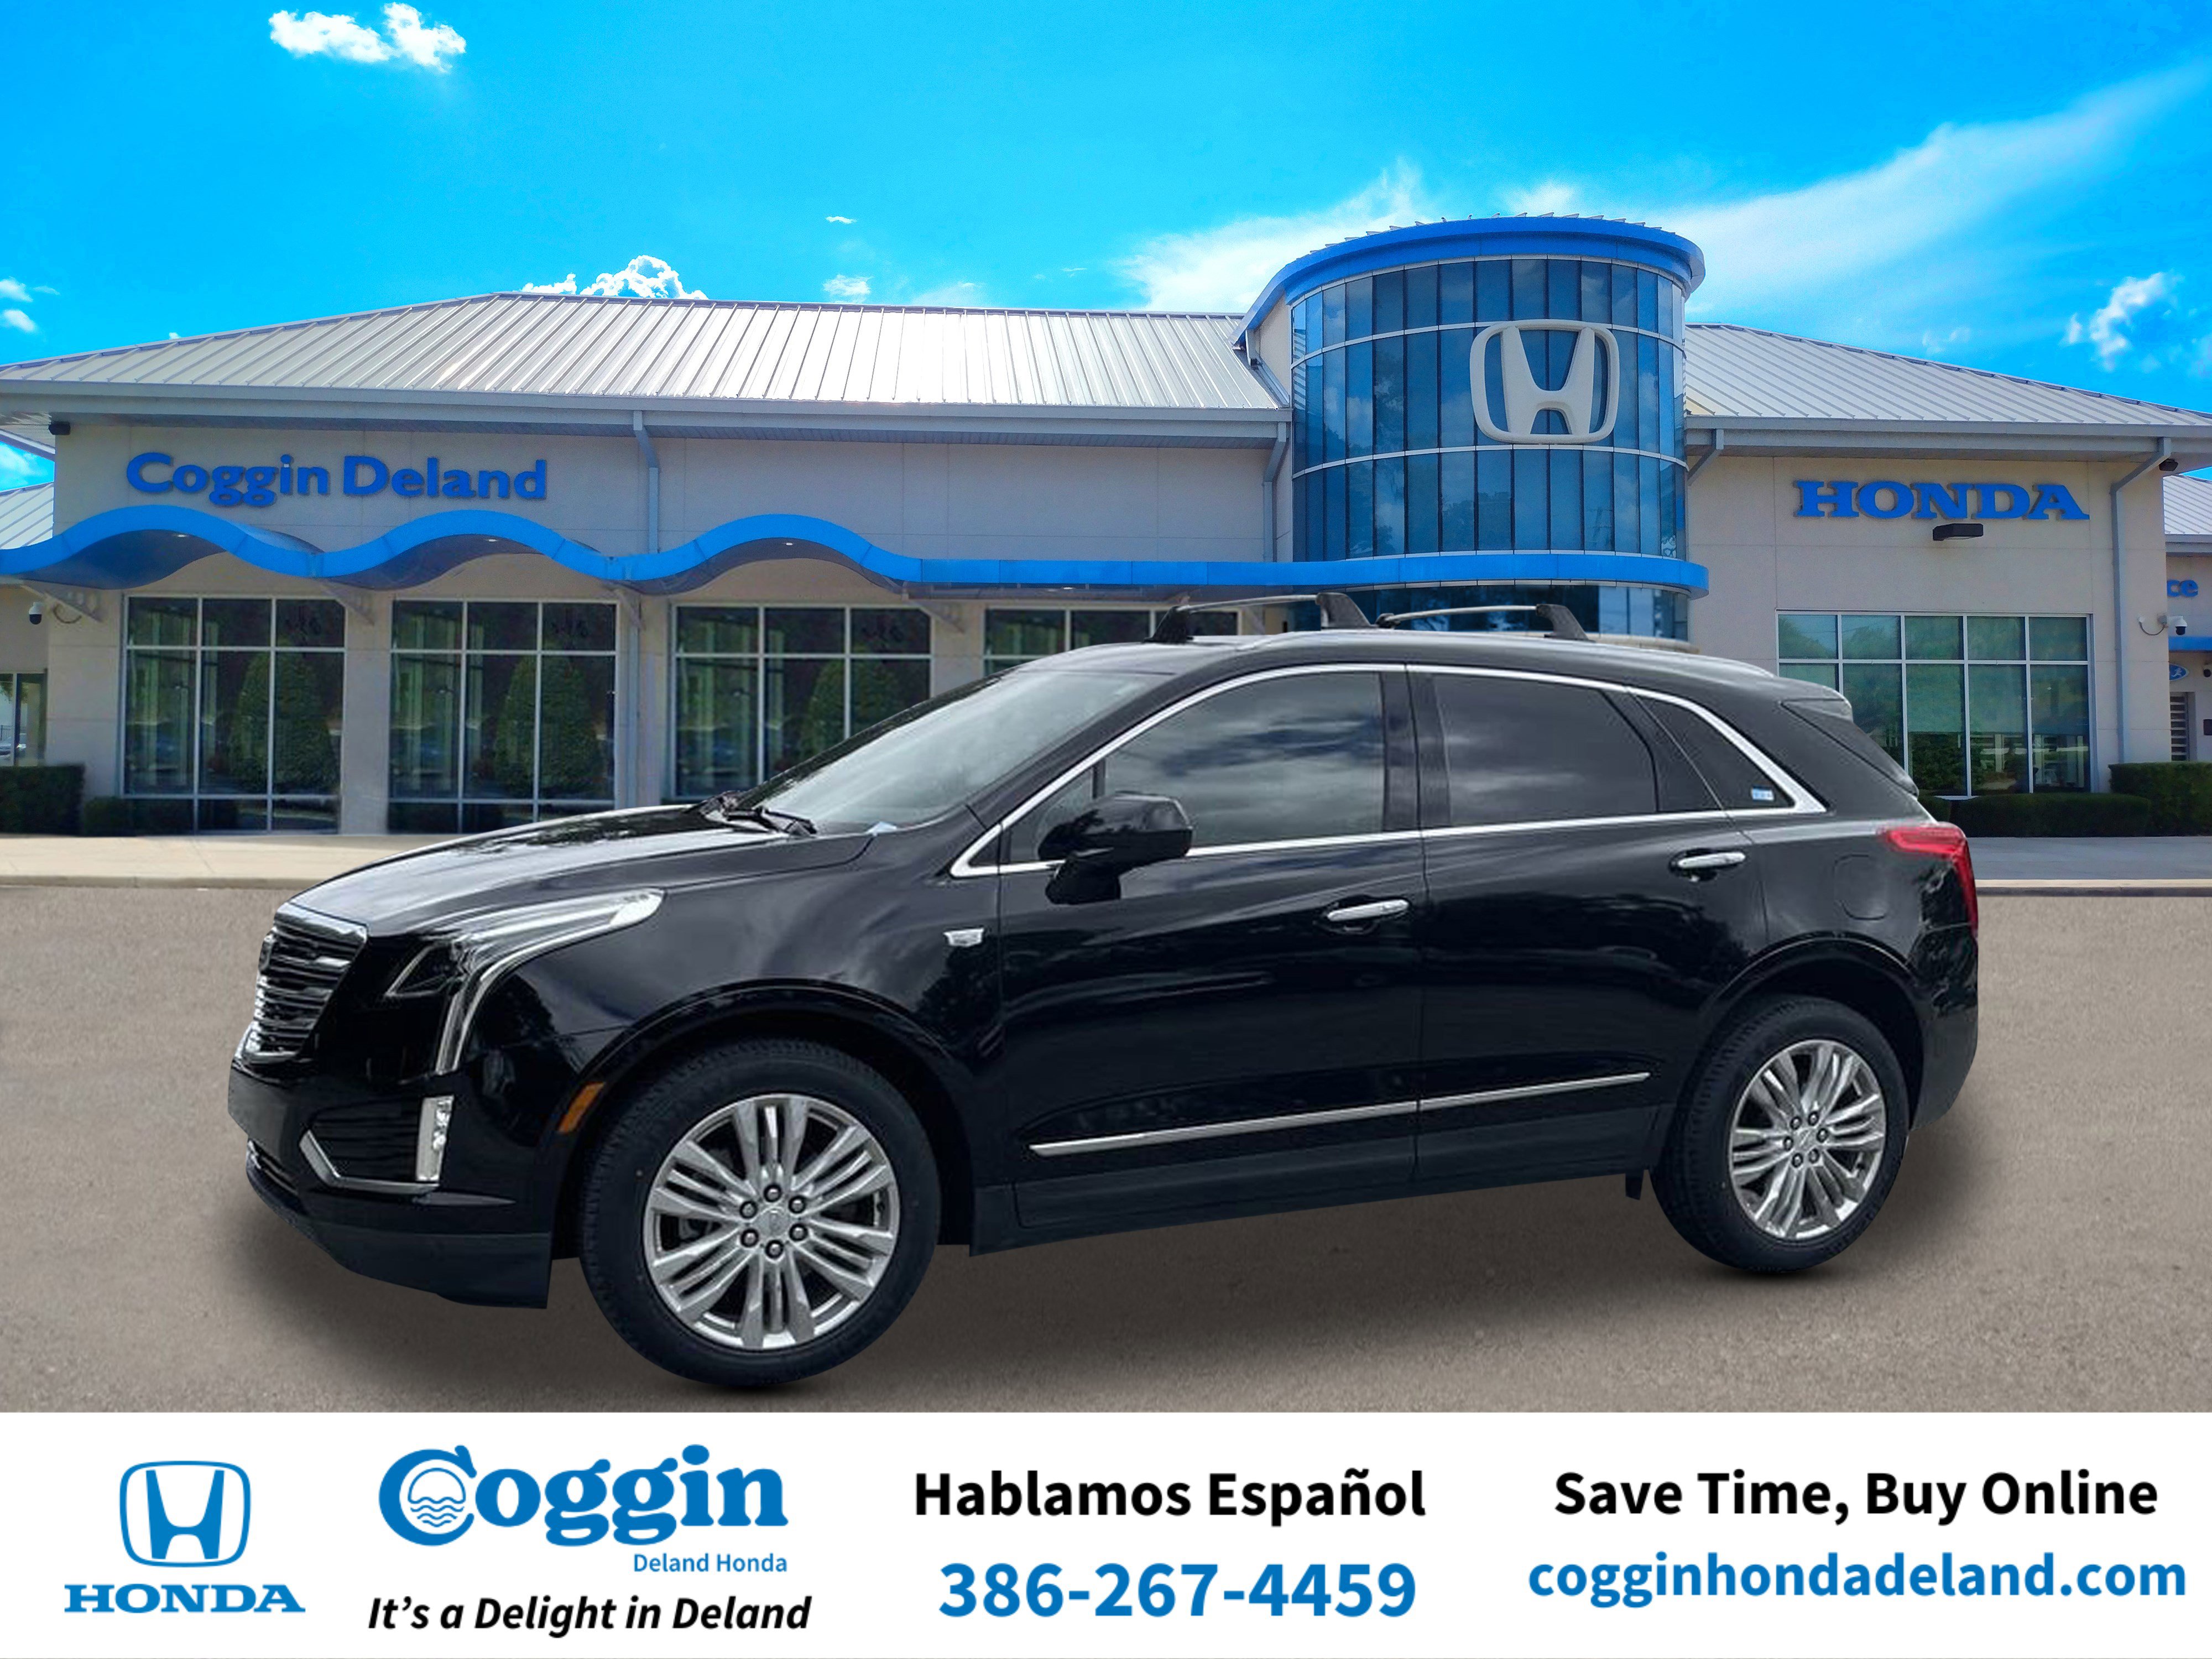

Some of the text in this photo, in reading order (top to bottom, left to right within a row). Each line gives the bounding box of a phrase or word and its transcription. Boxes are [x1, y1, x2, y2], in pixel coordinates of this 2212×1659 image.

[127, 452, 547, 505] Coggin Deland
[1796, 481, 2090, 520] HONDA
